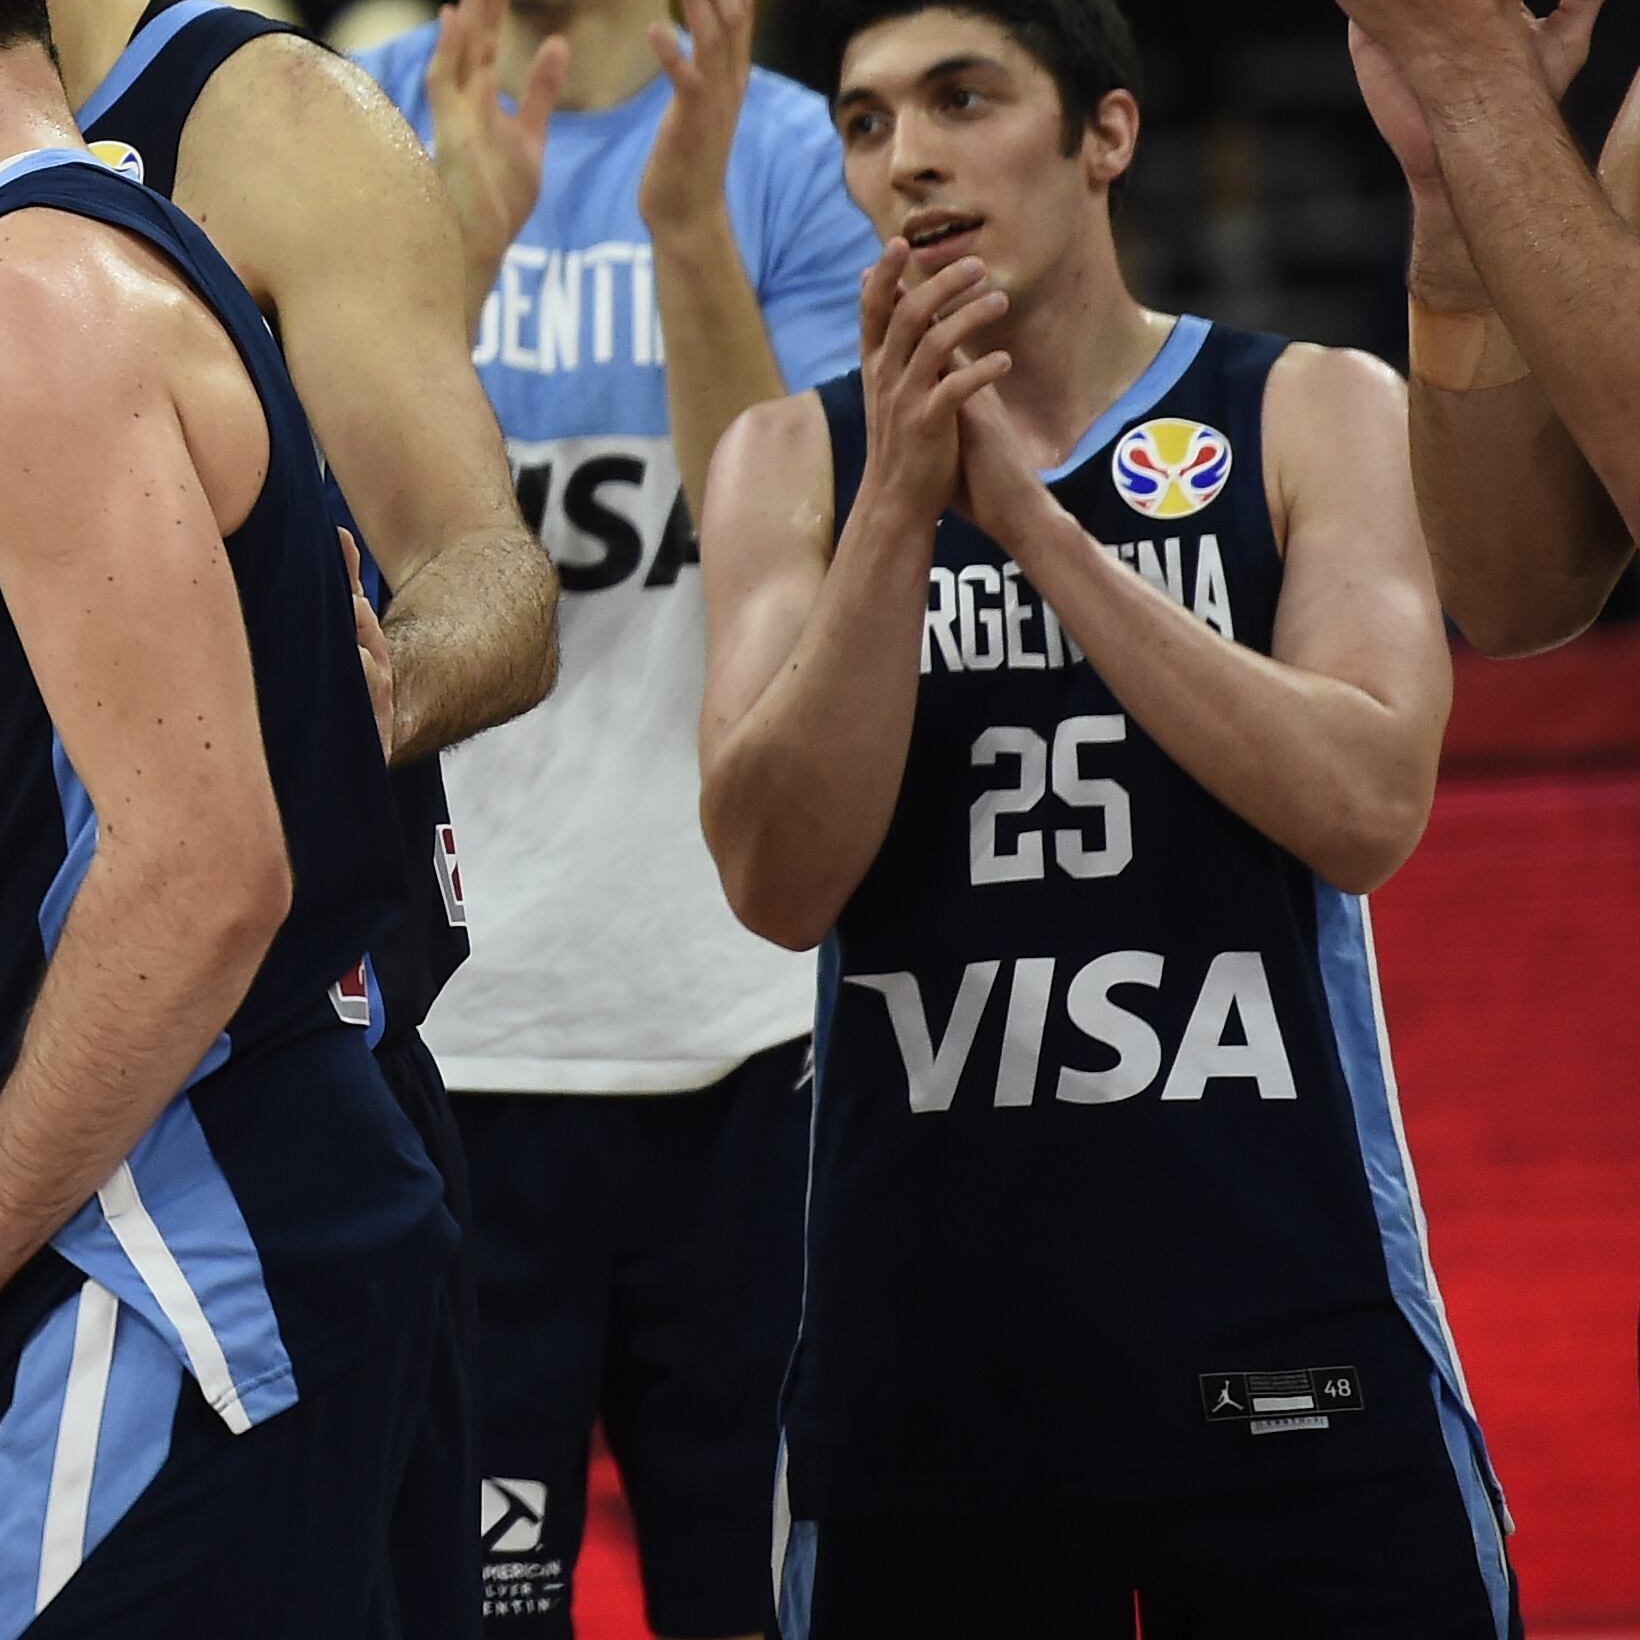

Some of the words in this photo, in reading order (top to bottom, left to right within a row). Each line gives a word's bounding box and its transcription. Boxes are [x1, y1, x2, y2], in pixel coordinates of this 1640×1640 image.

[970, 714, 1134, 886] 25
[844, 951, 1297, 1114] VISA
[1323, 1378, 1353, 1398] 48
